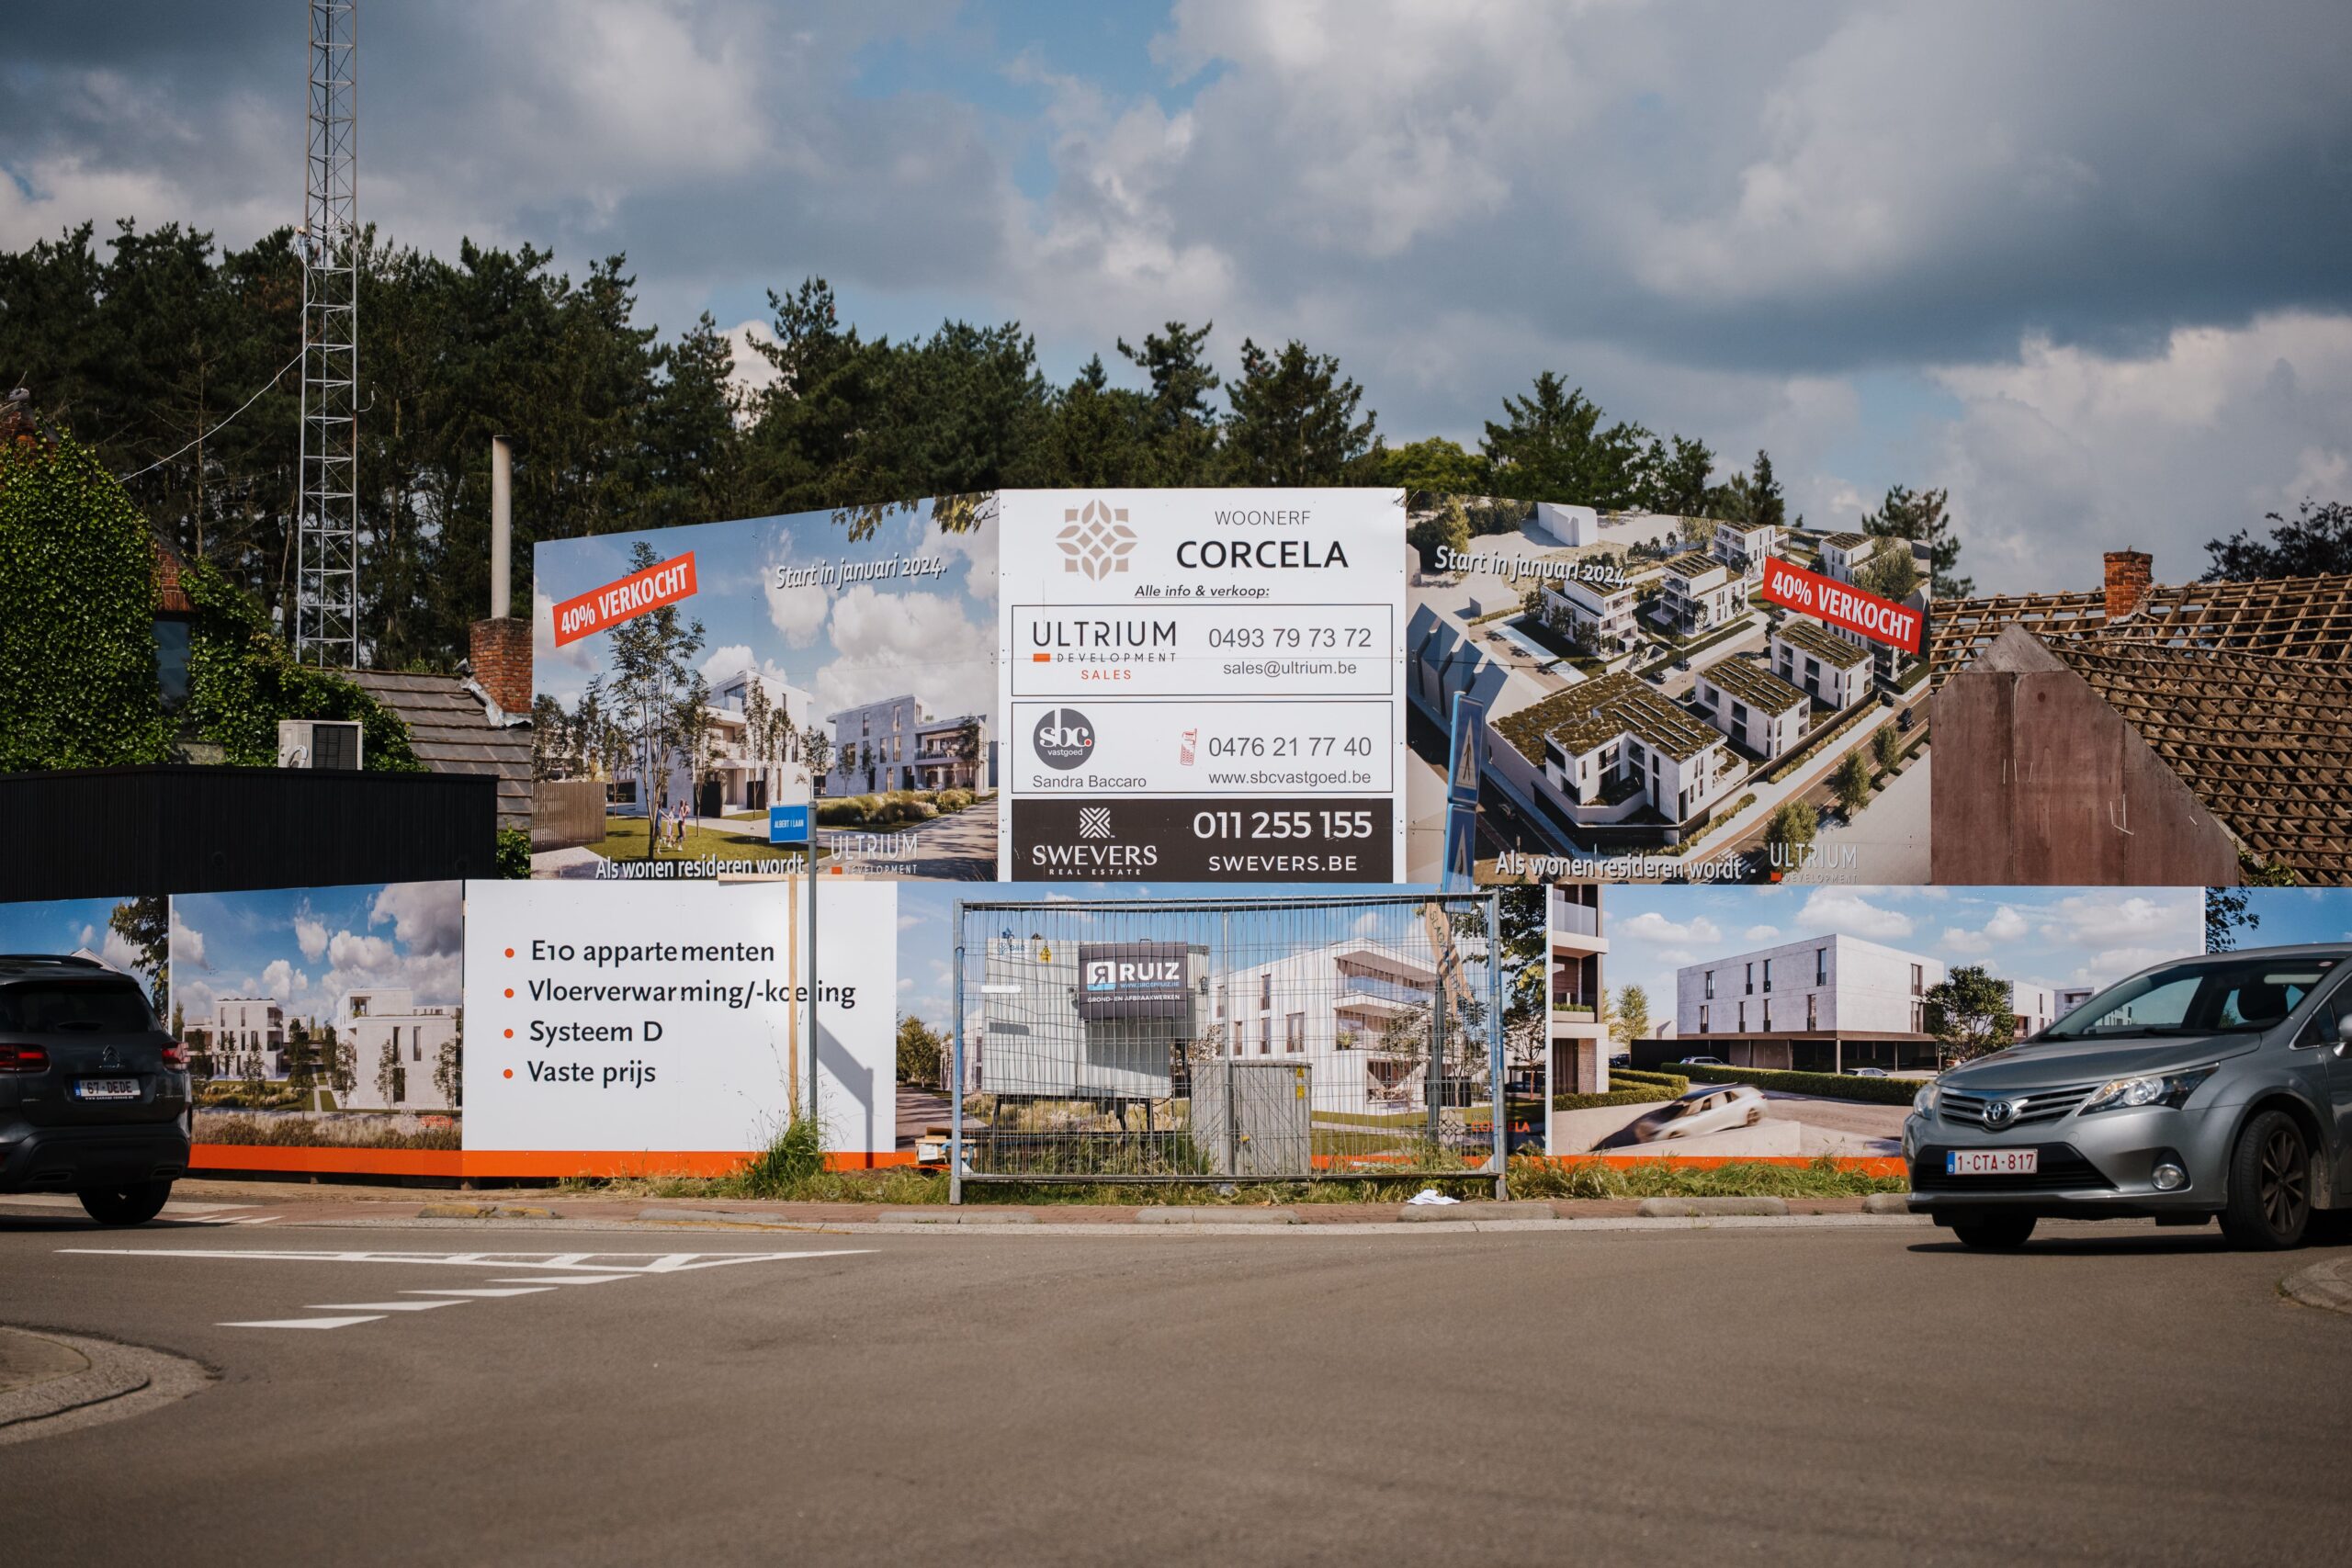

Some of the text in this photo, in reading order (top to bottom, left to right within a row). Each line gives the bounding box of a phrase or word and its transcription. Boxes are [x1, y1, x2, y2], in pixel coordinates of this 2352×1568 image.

[1215, 511, 1311, 525] WOONERF
[1176, 540, 1349, 569] CORCELA
[1434, 545, 1487, 573] Start
[1492, 549, 1509, 575] in
[1510, 552, 1580, 582] januari
[776, 564, 817, 589] Start
[820, 560, 834, 585] in
[836, 552, 899, 590] januari
[561, 562, 687, 634] 40% VERKOCHT
[1134, 585, 1270, 599] Alle info & verkoop:
[1771, 571, 1915, 642] 40% VERKOCHT
[1033, 621, 1176, 647] ULTRIUM
[1208, 628, 1372, 649] 0493 79 73 72
[1057, 653, 1176, 662] DEVELOPMENT
[1081, 670, 1131, 680] SALES
[1223, 661, 1356, 678] sales@ultrium.be
[1047, 749, 1082, 757] vastgoed
[1208, 737, 1372, 757] 0476 21 77 40
[1033, 774, 1147, 788] Sandra Baccaro
[1208, 771, 1371, 787] www.sbcvastgoed.be
[775, 820, 789, 829] ALBERT
[793, 819, 804, 828] LAAN
[1193, 811, 1373, 840] 011 255 155
[831, 833, 918, 861] ULTRIUM
[1032, 845, 1158, 865] SWEVERS
[1770, 842, 1858, 869] ULTRIUM
[595, 852, 805, 879] Als wonen resideren wordt
[844, 864, 917, 874] DEVELOPMENT
[1208, 856, 1358, 872] SWEVERS.BE
[1495, 850, 1526, 875] Als
[1530, 856, 1595, 876] wonen
[1600, 853, 1685, 879] resideren
[1689, 855, 1742, 880] wordt
[1785, 874, 1857, 884] DEVELOPMENT
[531, 940, 775, 967] E10 appartementen
[1119, 962, 1180, 981] RUIZ
[528, 979, 856, 1009] Vloerverwarming/-koeing
[529, 1020, 663, 1048] Systeem D
[527, 1060, 656, 1089] Vaste prijs
